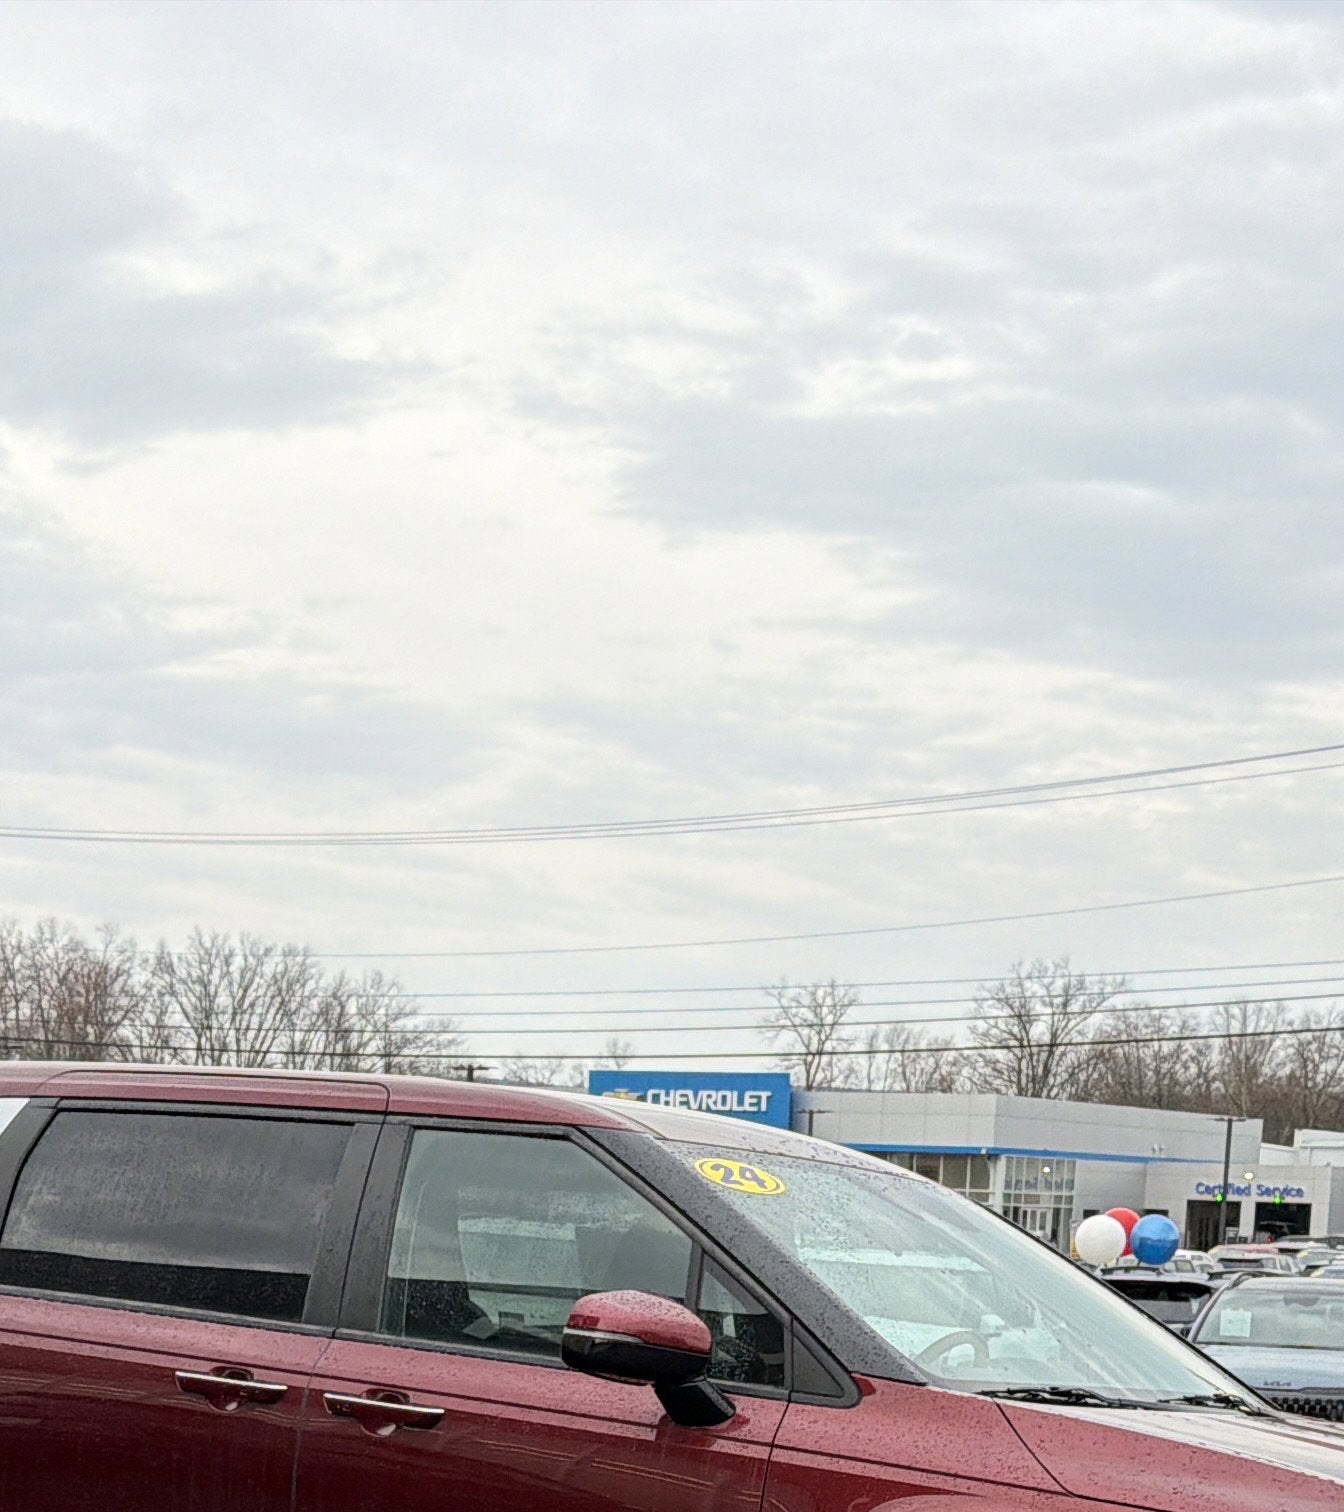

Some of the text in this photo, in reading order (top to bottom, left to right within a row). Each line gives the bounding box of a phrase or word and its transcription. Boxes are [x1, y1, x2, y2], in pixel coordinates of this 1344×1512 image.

[647, 1089, 772, 1112] CHEVROLET
[709, 1163, 769, 1190] 24
[1196, 1182, 1304, 1198] Certfied Service
